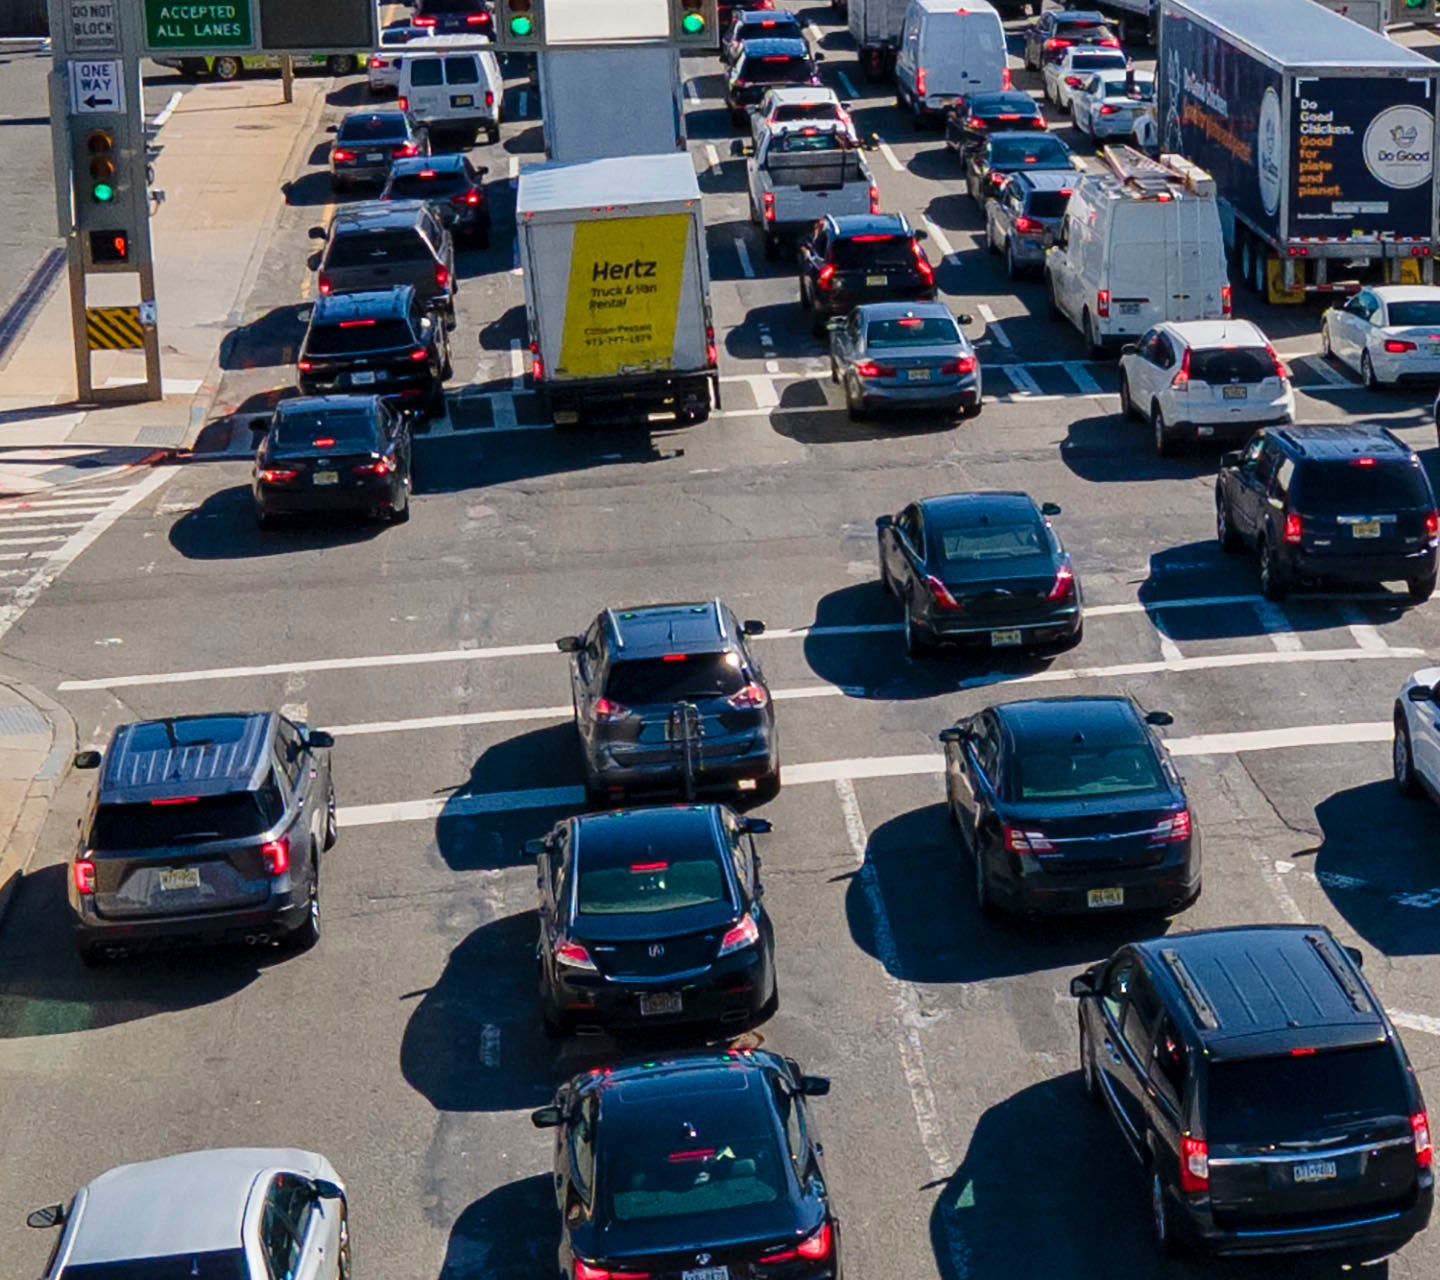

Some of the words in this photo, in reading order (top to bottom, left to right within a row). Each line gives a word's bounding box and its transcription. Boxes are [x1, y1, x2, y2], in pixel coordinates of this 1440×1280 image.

[72, 5, 87, 18] DO
[91, 5, 113, 17] NOT
[160, 5, 236, 19] ACCEPTED
[74, 22, 113, 35] BLOCK
[157, 24, 185, 37] ALL
[194, 23, 242, 36] LANES
[81, 64, 110, 76] ONE
[80, 79, 112, 92] WAY
[1301, 99, 1318, 109] Do
[1300, 110, 1334, 122] Good
[1300, 122, 1355, 135] Chicken.
[1300, 135, 1334, 147] Good
[1299, 147, 1320, 159] for
[1378, 150, 1394, 161] Do
[1396, 149, 1430, 161] Good
[1299, 160, 1333, 173] plate
[1298, 172, 1324, 183] and
[592, 259, 657, 282] Hertz
[591, 286, 623, 298] Truck
[625, 285, 633, 295] &
[589, 298, 627, 311] Rental
